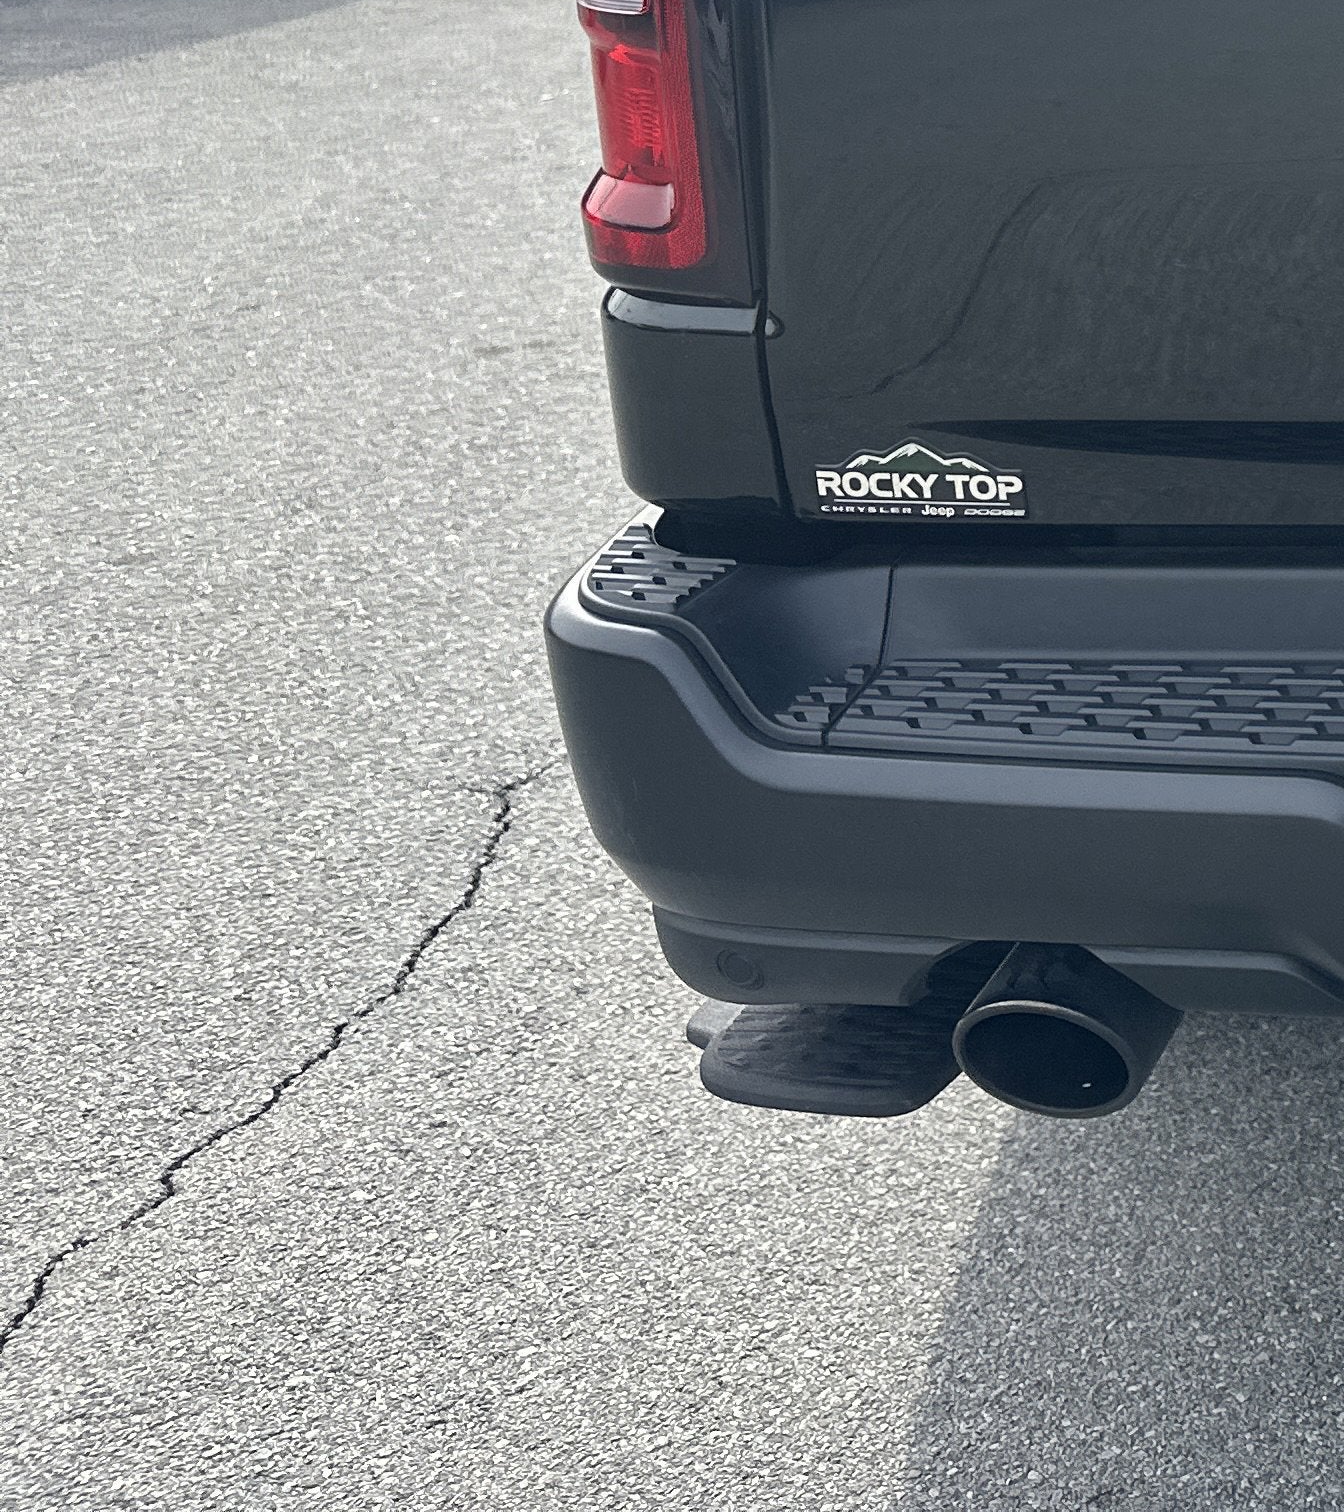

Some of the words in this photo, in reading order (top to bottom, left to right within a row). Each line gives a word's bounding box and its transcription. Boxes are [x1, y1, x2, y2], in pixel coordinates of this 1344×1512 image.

[815, 470, 939, 499] ROCKY
[945, 473, 1024, 501] TOP
[820, 505, 912, 514] CHRYSLER
[921, 504, 955, 518] Jeep
